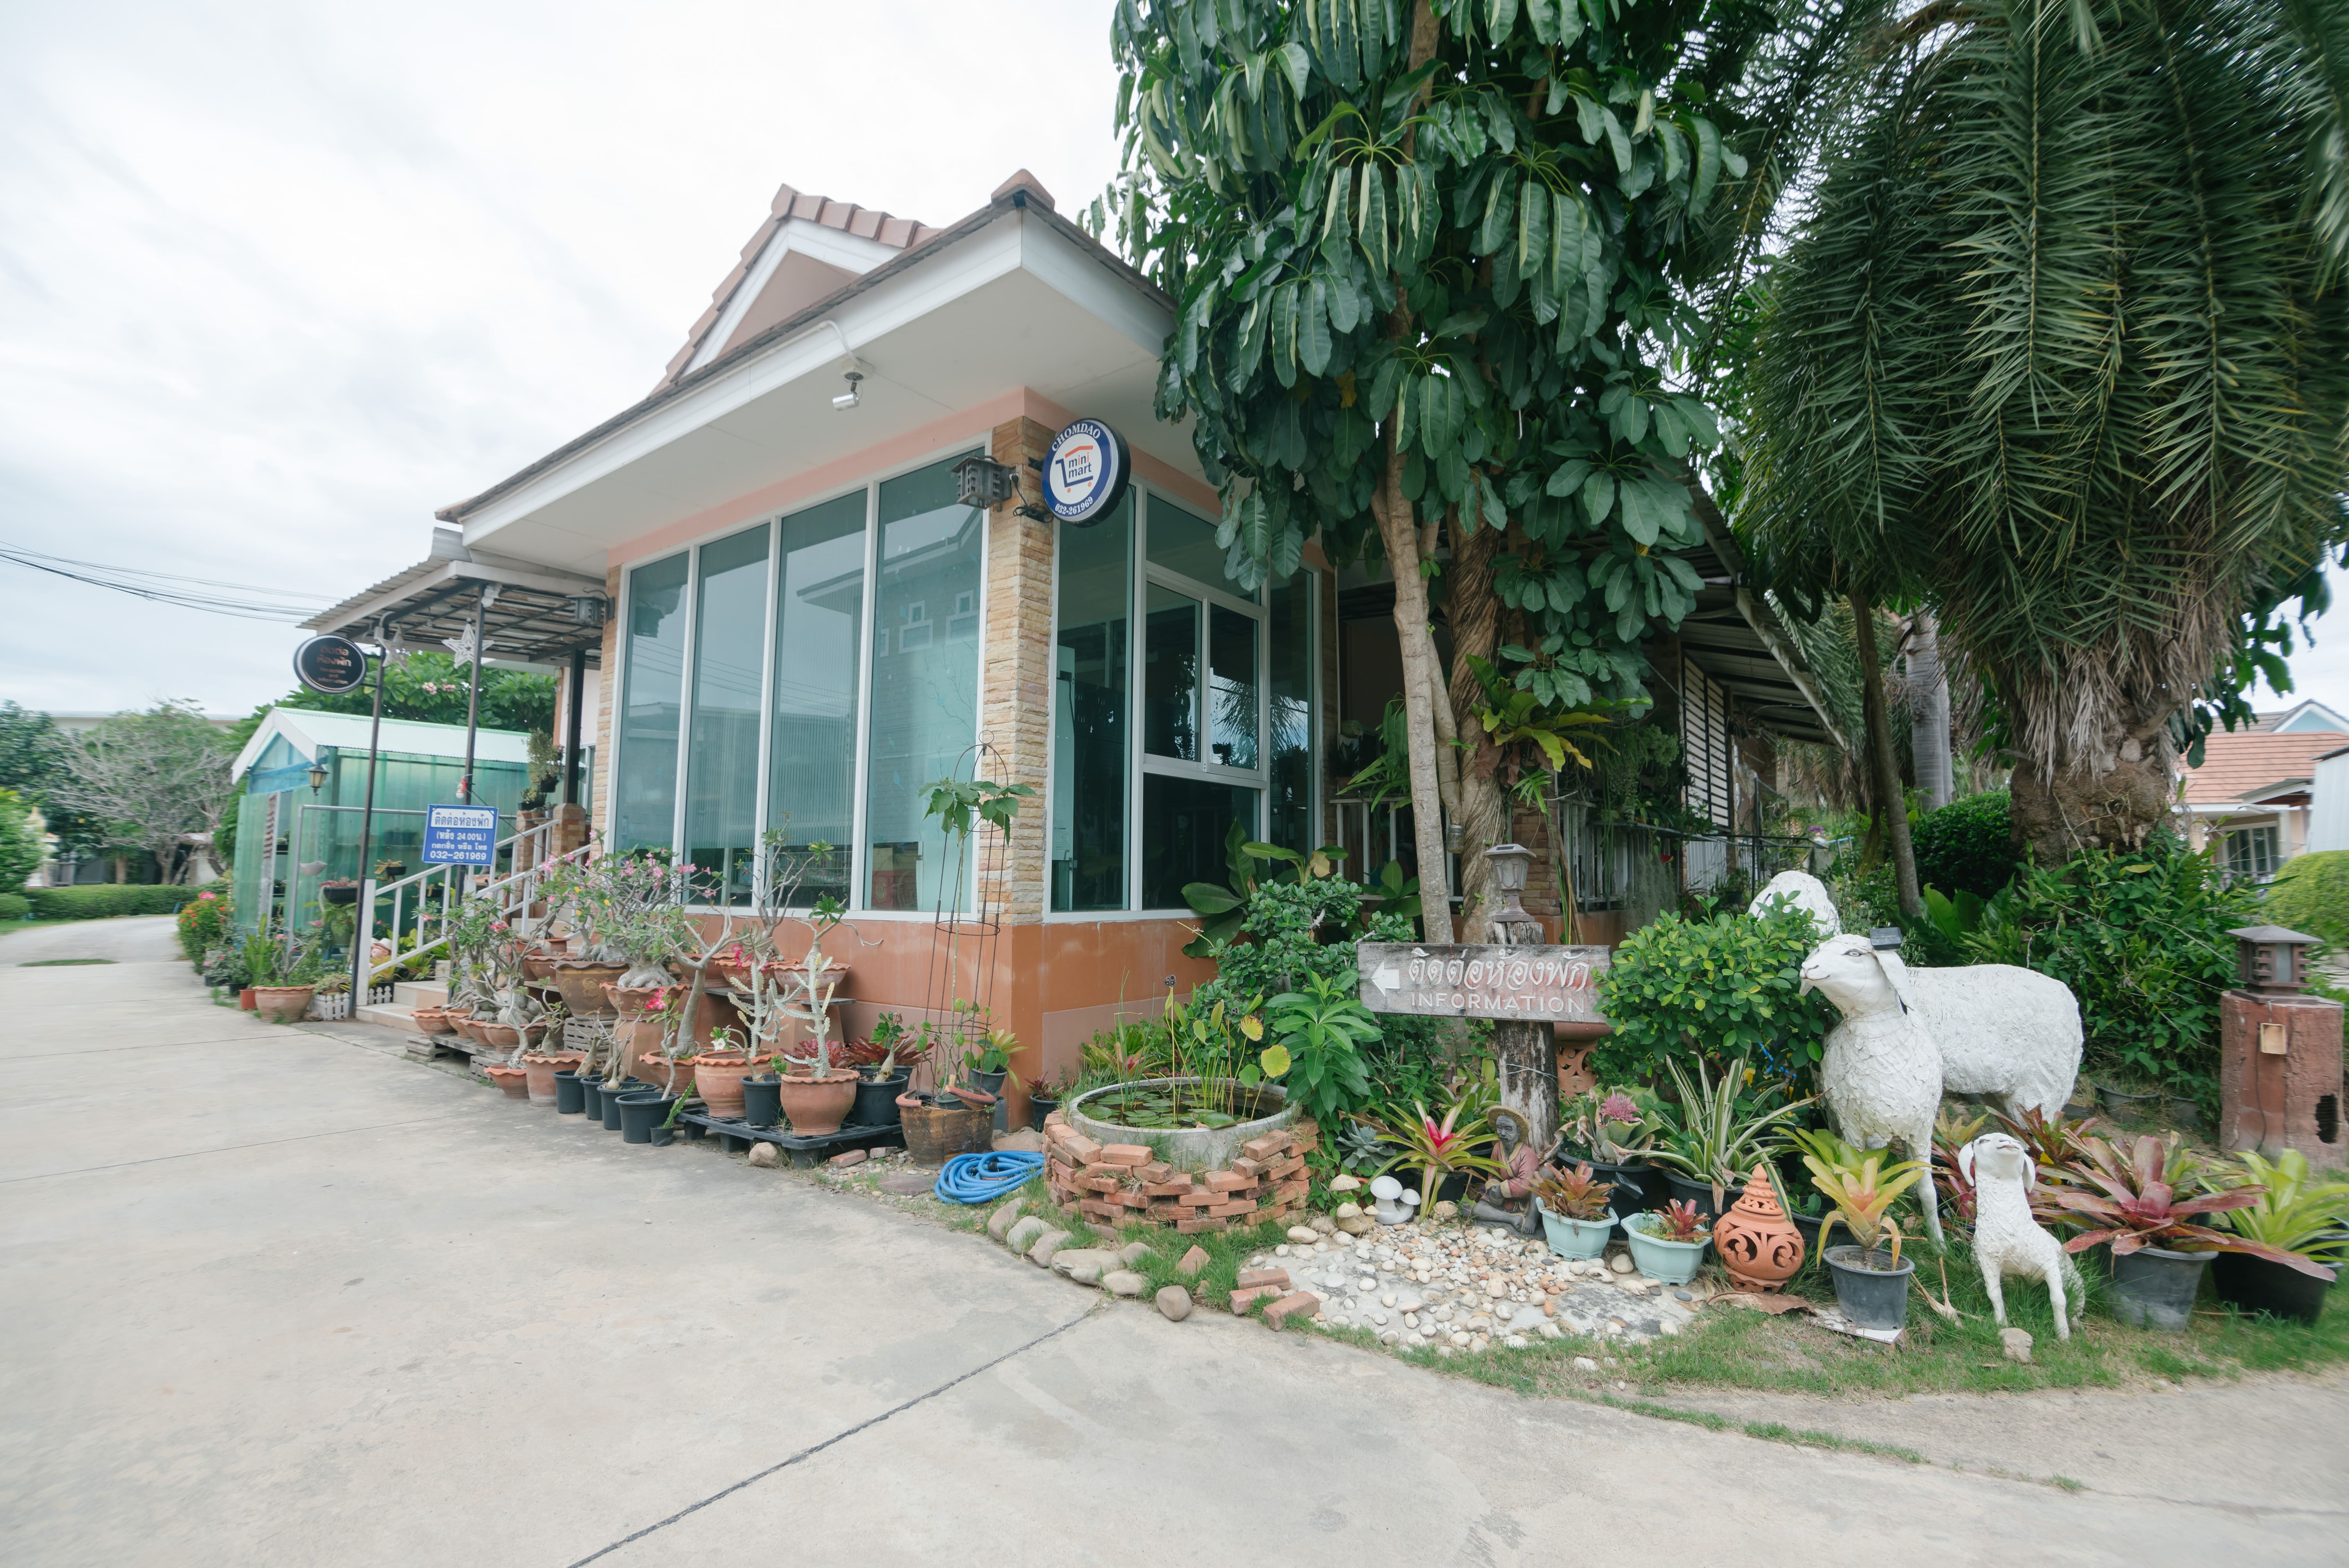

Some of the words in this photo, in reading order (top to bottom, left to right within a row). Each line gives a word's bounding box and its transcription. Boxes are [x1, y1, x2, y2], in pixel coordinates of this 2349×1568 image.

[1052, 423, 1100, 451] CHOMDAO
[1069, 452, 1089, 468] mini
[1069, 462, 1092, 479] mart
[1055, 496, 1093, 515] 032-261969
[435, 812, 489, 827] ติดต่อห้องพัก
[474, 842, 488, 850] โทร
[430, 850, 487, 861] 032-261969
[1408, 946, 1590, 992] ติดต่อห้องพัก
[1411, 992, 1584, 1013] INFORMATION
